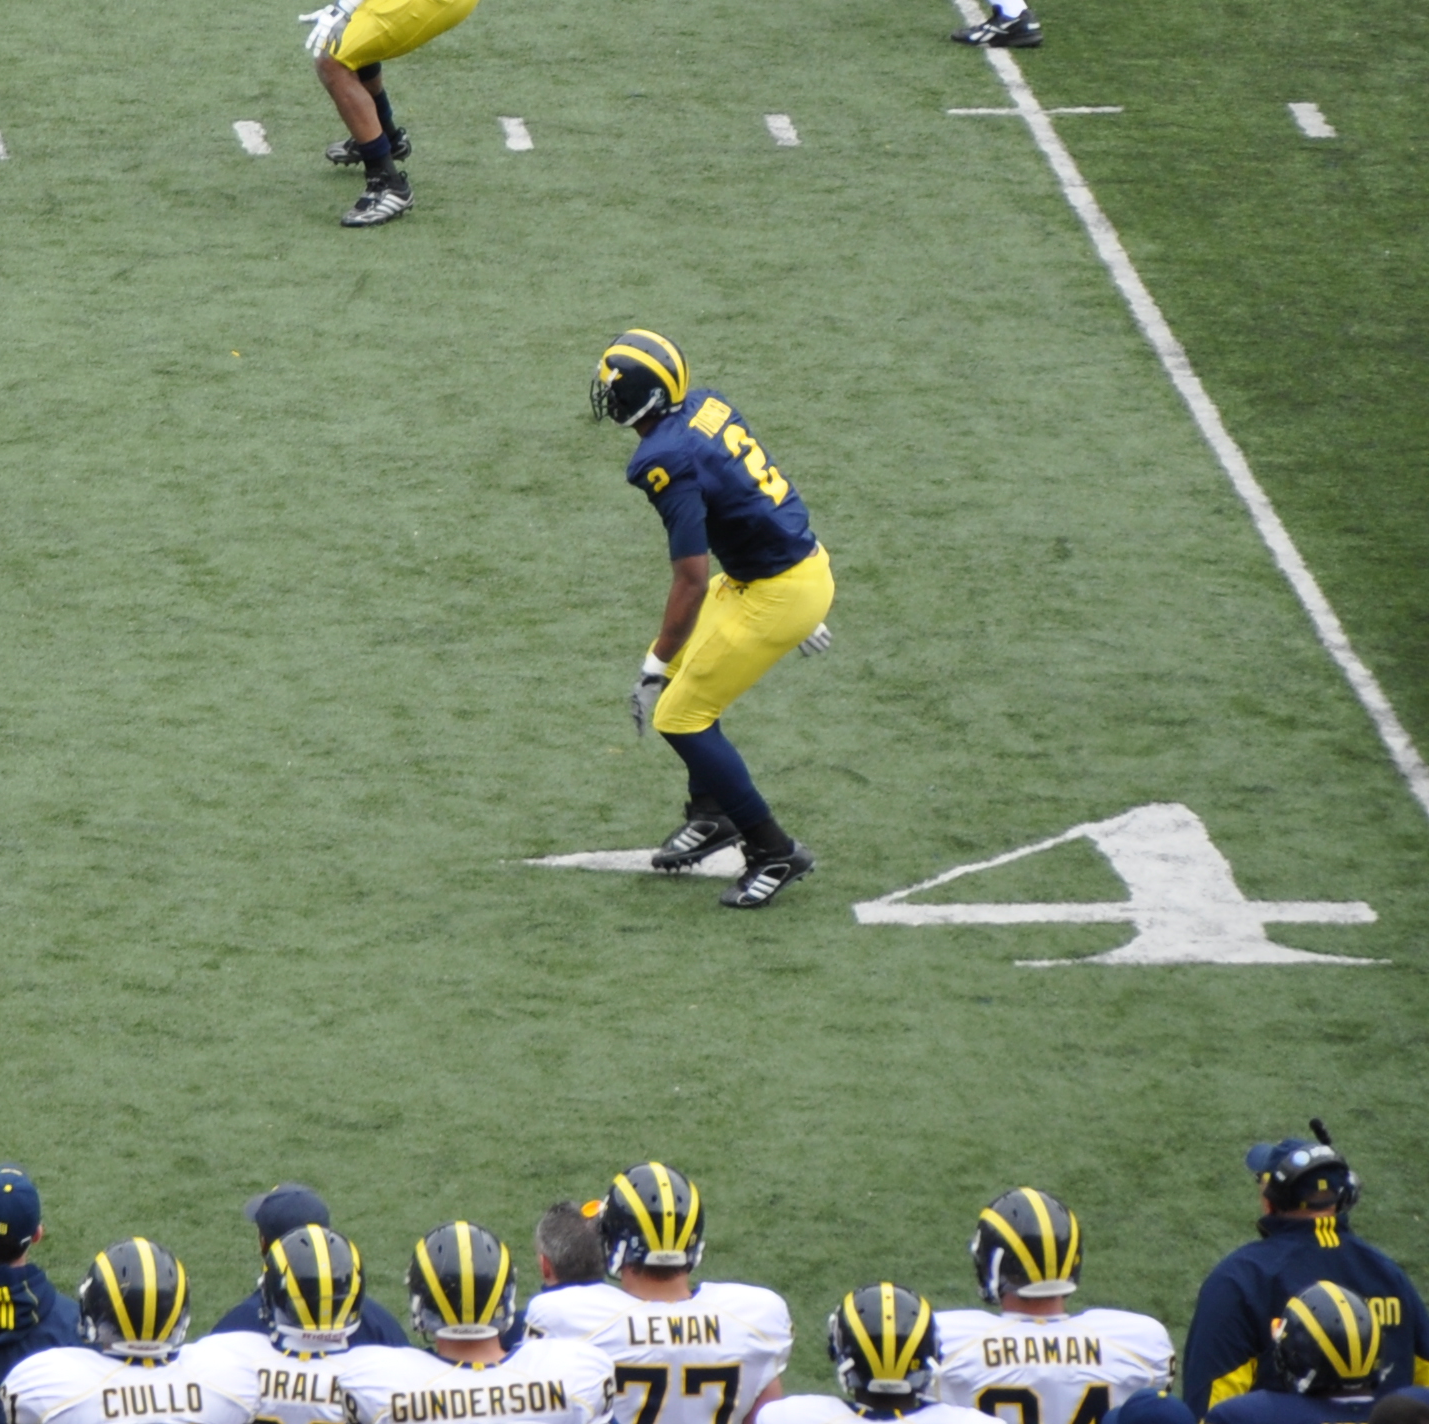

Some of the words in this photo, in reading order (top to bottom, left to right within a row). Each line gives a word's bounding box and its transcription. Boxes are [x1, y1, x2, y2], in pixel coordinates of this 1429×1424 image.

[722, 423, 790, 507] 2
[627, 1314, 721, 1346] LEWAN
[982, 1336, 1102, 1368] GRAMAN
[102, 1382, 203, 1418] CIULLO
[391, 1379, 567, 1423] GUNDERSON
[614, 1362, 742, 1424] 77
